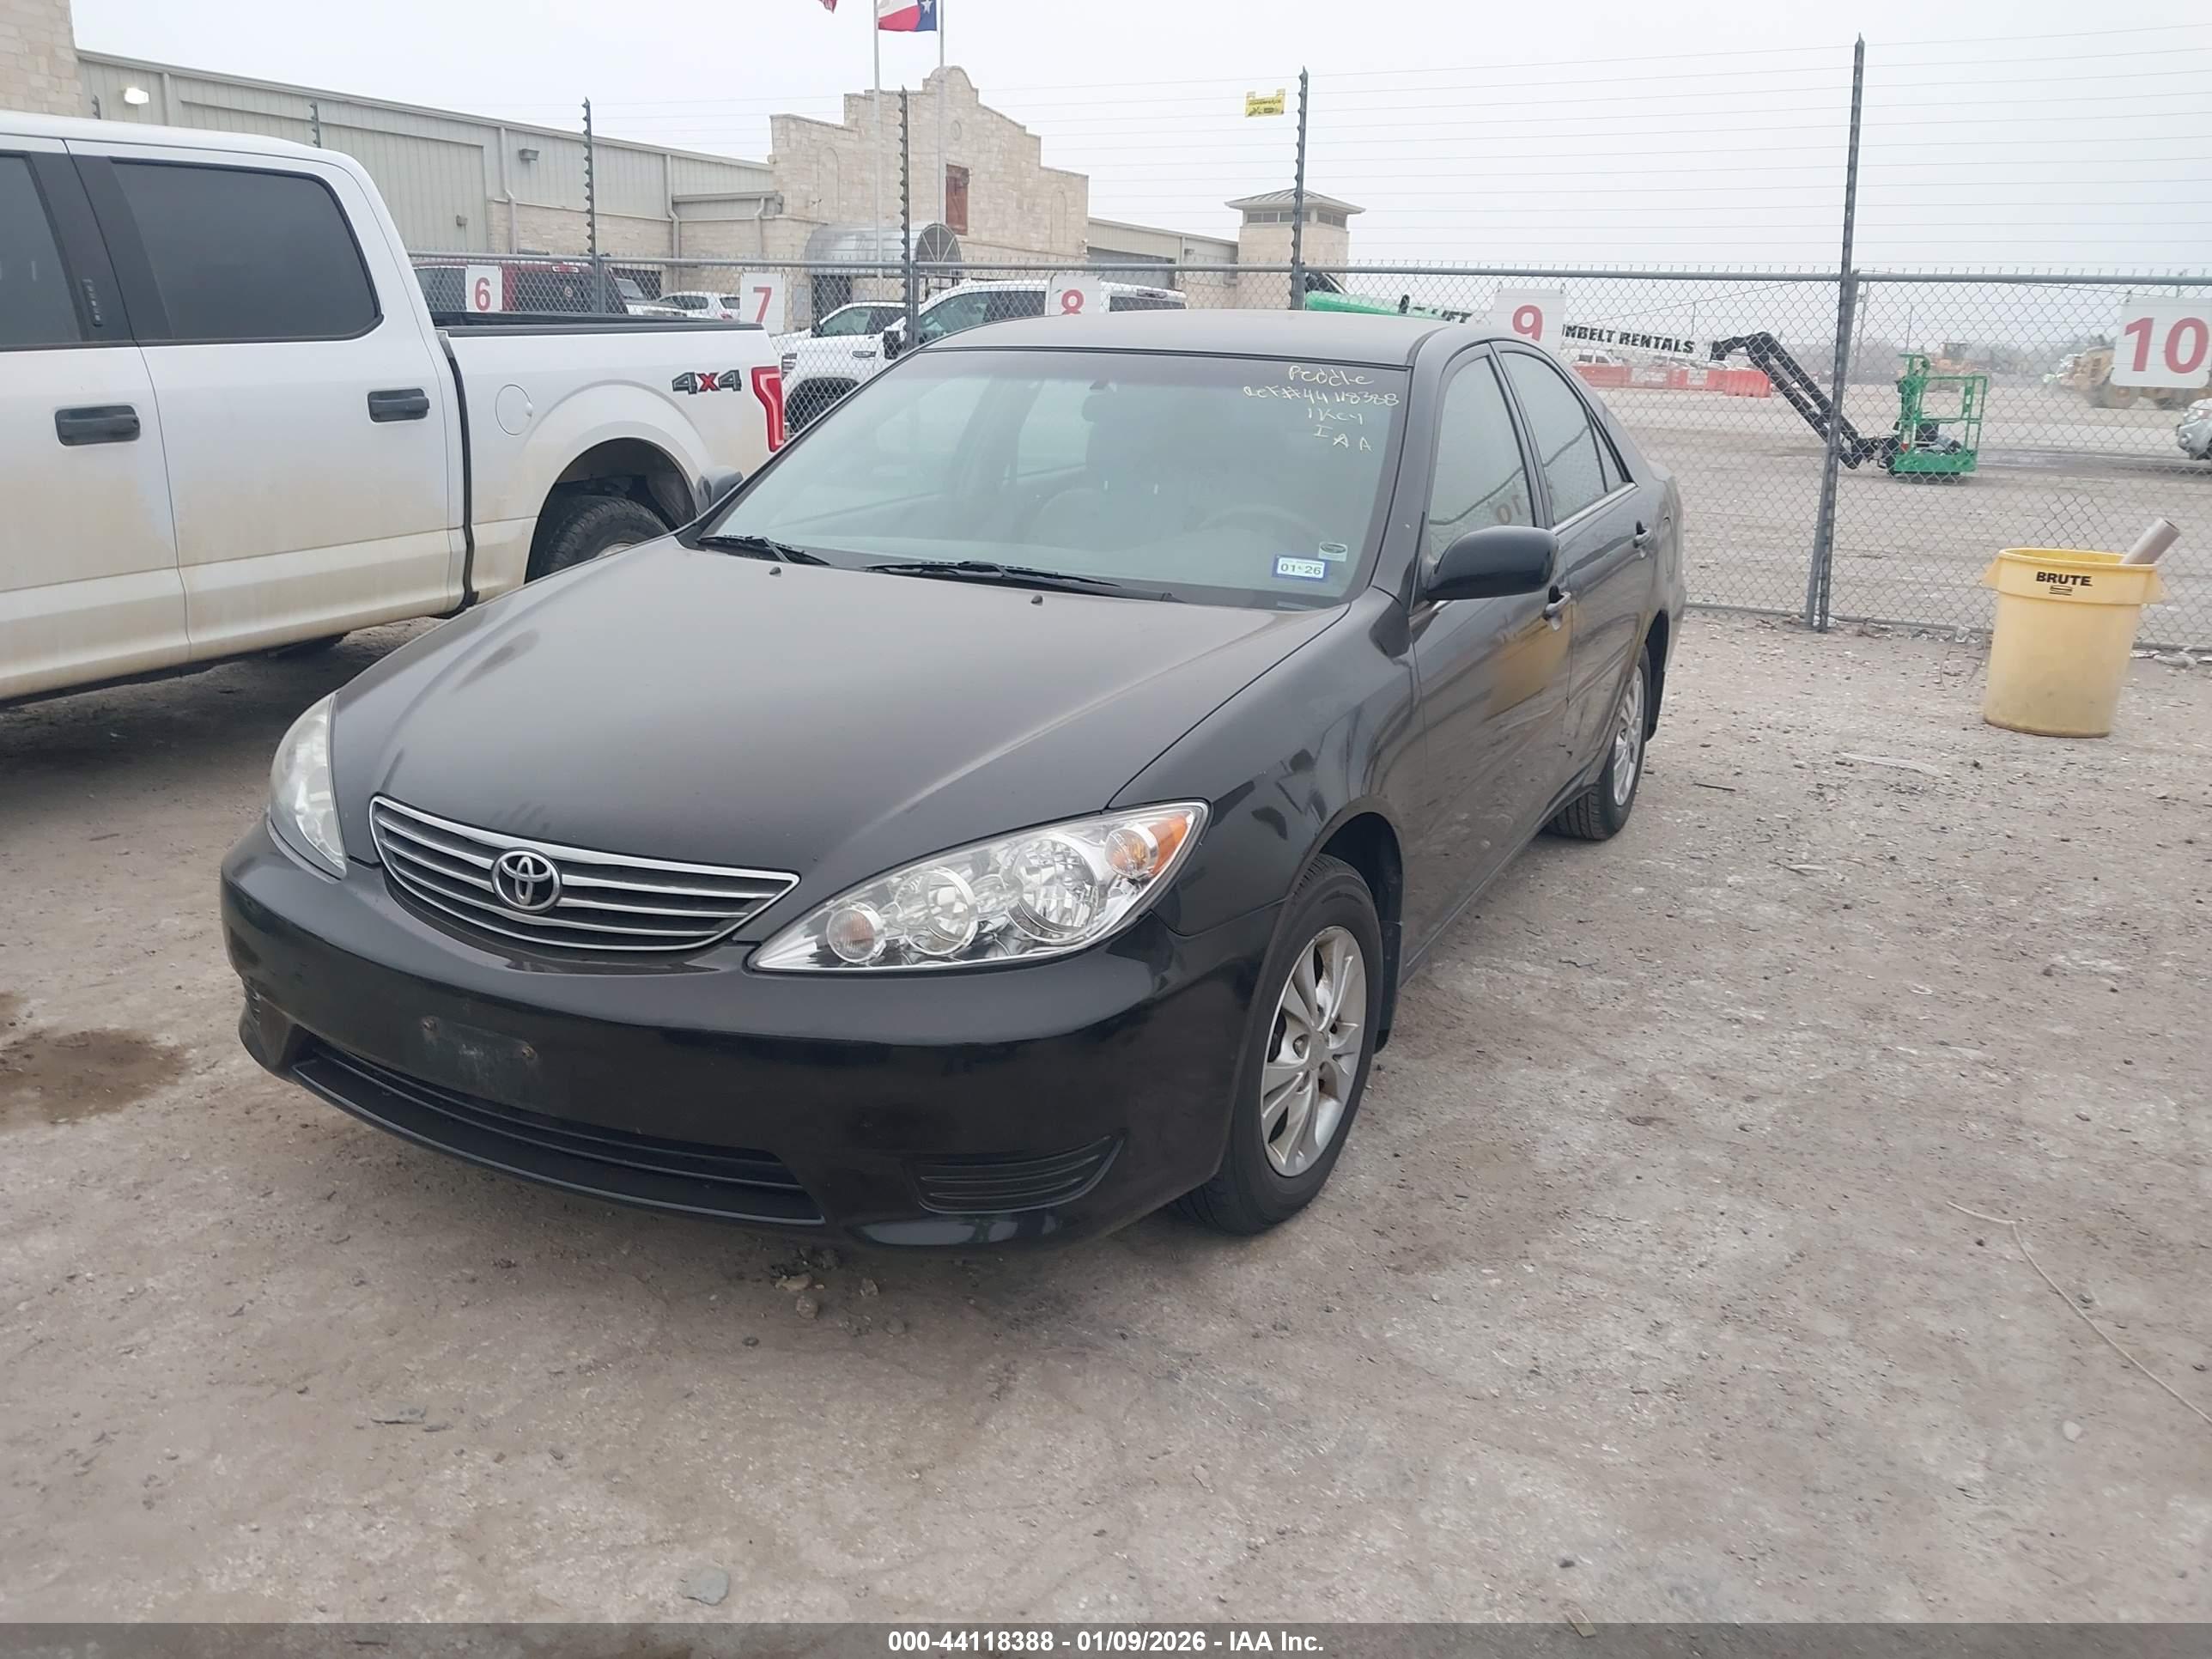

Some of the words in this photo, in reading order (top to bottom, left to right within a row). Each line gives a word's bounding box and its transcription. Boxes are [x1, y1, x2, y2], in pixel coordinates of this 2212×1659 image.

[475, 276, 490, 312] 6
[753, 287, 772, 323] 7
[1061, 289, 1085, 315] 8
[1512, 305, 1543, 342] 9
[1619, 331, 1695, 354] RENTALS
[2124, 317, 2209, 374] 10
[2036, 571, 2093, 586] BRUTE
